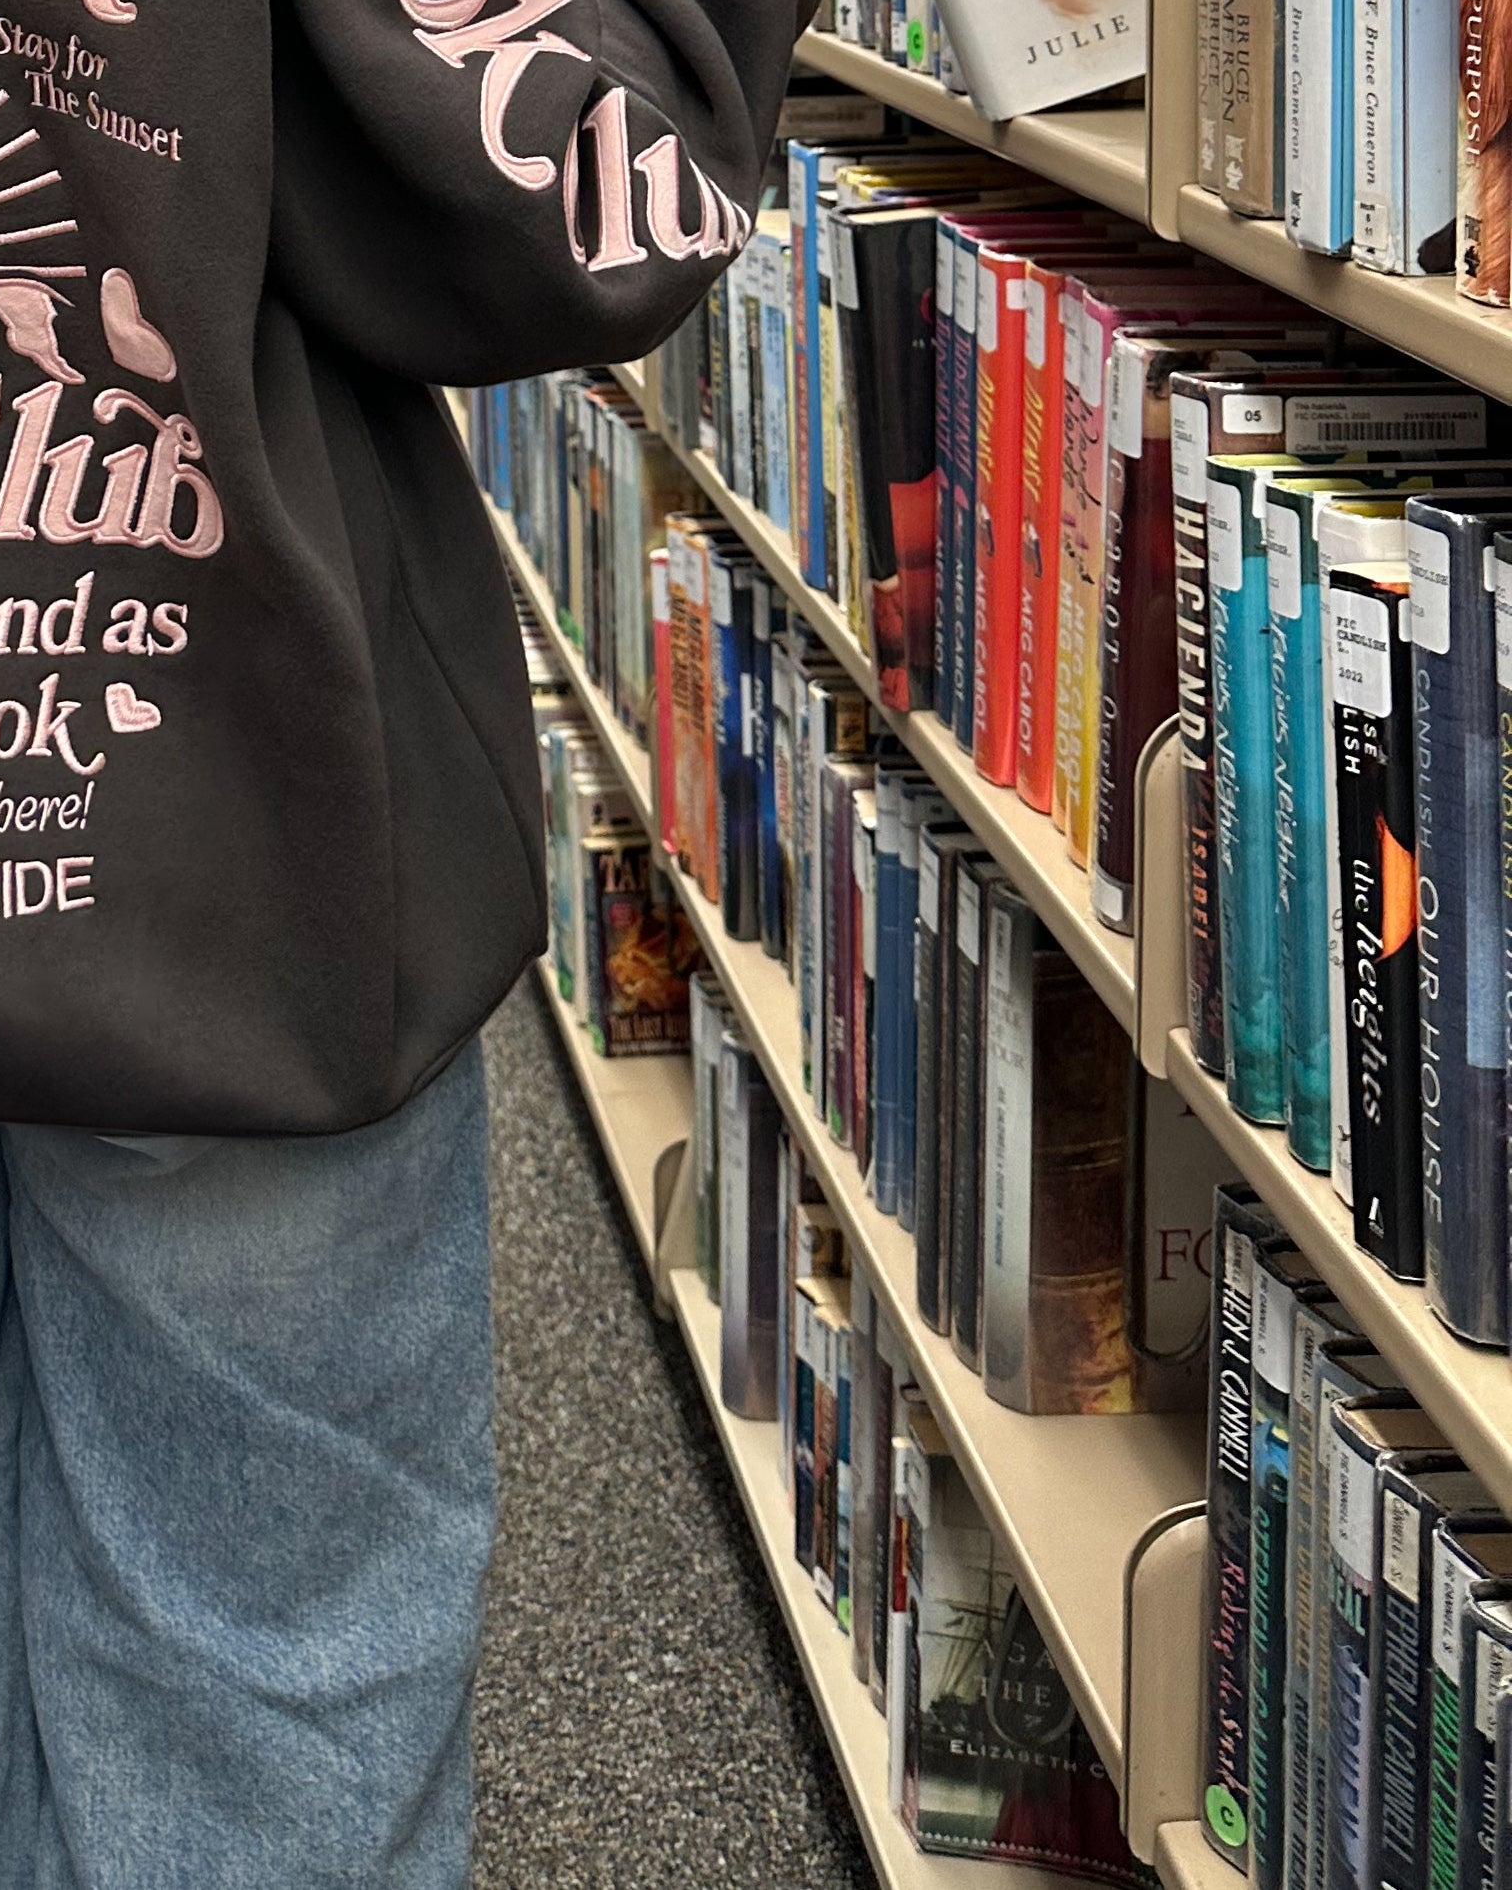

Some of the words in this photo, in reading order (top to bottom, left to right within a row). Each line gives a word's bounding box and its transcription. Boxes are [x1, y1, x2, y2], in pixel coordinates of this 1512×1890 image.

[61, 37, 110, 84] for
[1025, 13, 1133, 67] JULIE
[1236, 13, 1250, 104] BRUCE
[1364, 24, 1379, 86] Bruce
[23, 71, 83, 119] The
[85, 92, 185, 163] Sunset
[1364, 91, 1380, 185] Cameron
[1244, 410, 1262, 423] 05
[101, 601, 190, 658] as
[933, 592, 945, 676] CABOT
[974, 566, 986, 632] MEG
[1019, 588, 1032, 651] MEG
[1336, 615, 1358, 630] FIC
[952, 618, 965, 700] CABOT
[1175, 510, 1208, 773] HACIENDA
[1338, 666, 1364, 683] 2022
[973, 645, 987, 730] CABOT
[1018, 659, 1032, 759] CABOT
[1342, 708, 1361, 775] LISH
[1413, 667, 1433, 850] CANDLISH
[1191, 825, 1209, 941] ISABEL
[1351, 858, 1377, 911] the
[1417, 875, 1441, 1001] OUR
[1351, 916, 1390, 1126] heights
[1418, 1016, 1445, 1224] HOUSE
[1218, 1368, 1250, 1481] CANNELL
[949, 1738, 1078, 1774] ELIZABETH
[1381, 1725, 1417, 1864] CANNELL
